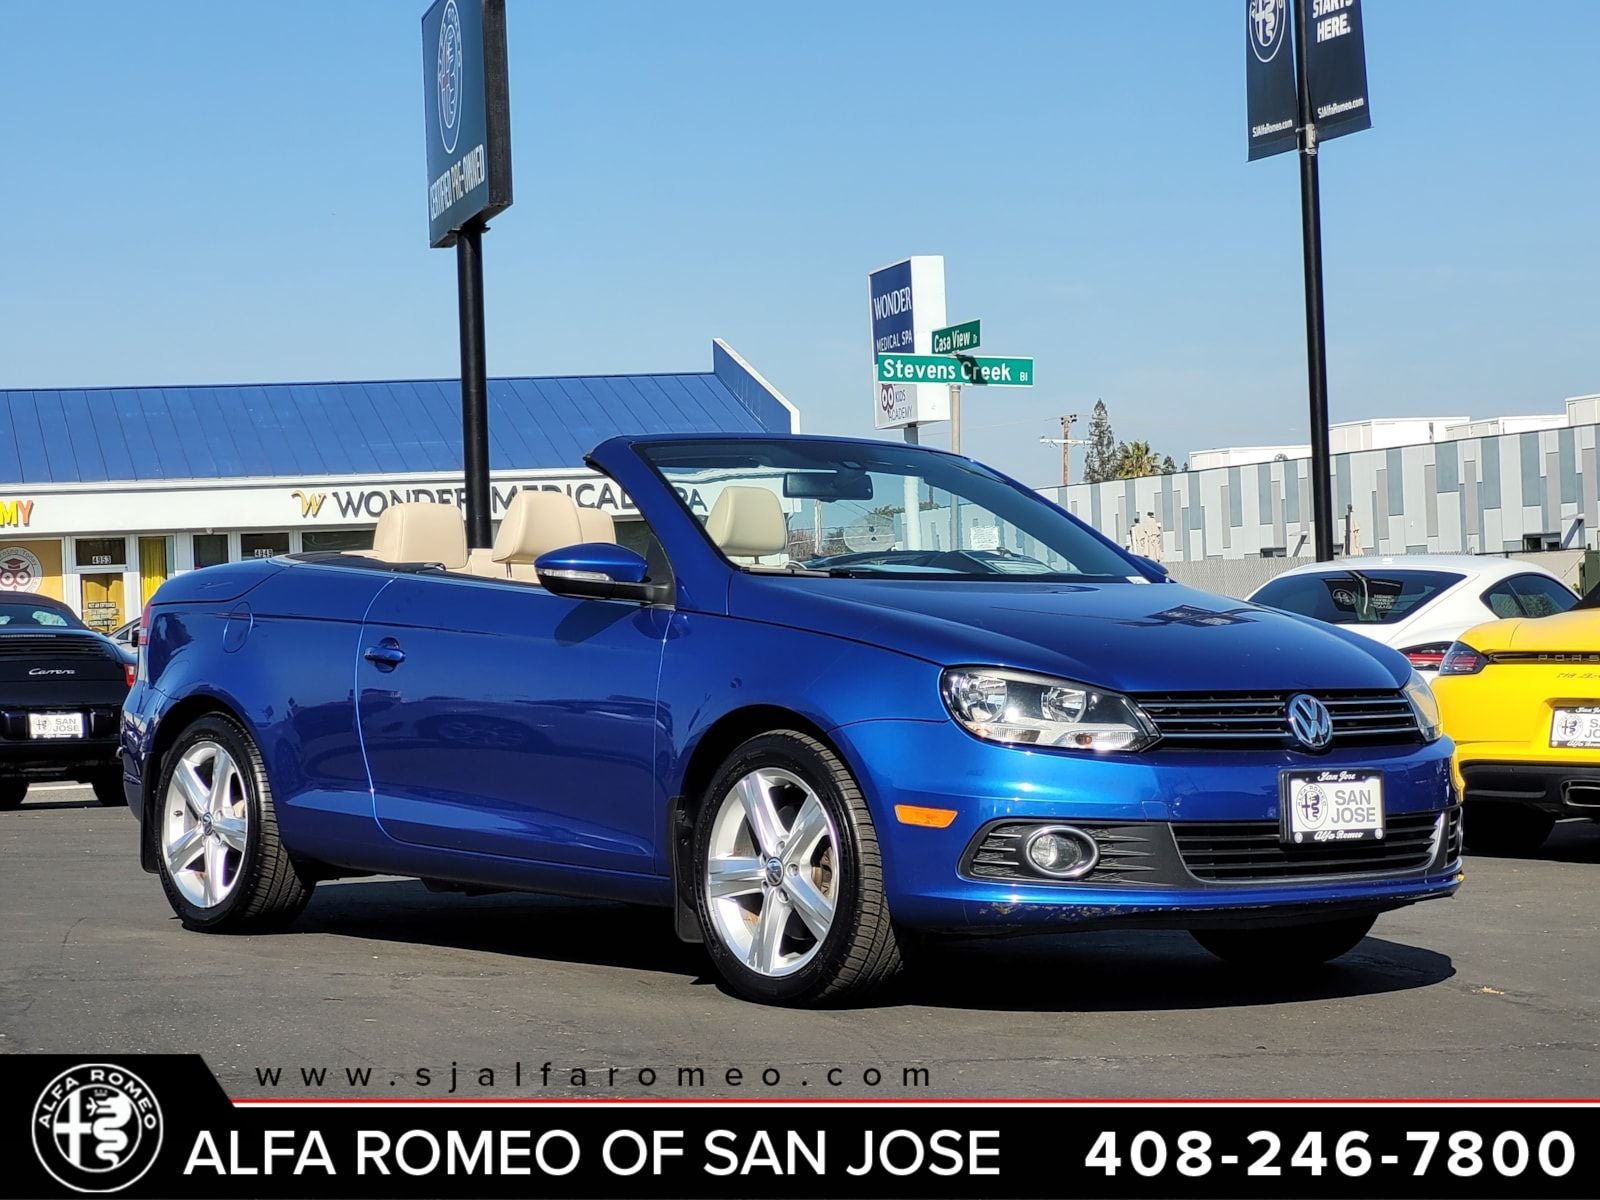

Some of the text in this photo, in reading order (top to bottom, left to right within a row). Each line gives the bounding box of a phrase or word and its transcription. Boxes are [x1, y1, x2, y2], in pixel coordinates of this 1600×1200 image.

[1317, 12, 1351, 43] HERE.
[1317, 97, 1364, 119] SJAlfaRomeo.com
[1252, 119, 1293, 138] SJAlfaRomeo.com
[451, 144, 485, 204] PRE-OWNED
[873, 286, 912, 320] WONDER
[876, 329, 913, 353] MEDICAL SPA
[934, 335, 951, 353] Casa
[952, 329, 970, 348] View
[883, 358, 956, 380] Stevens
[960, 361, 1012, 381] Creek
[673, 486, 708, 512] PA
[53, 724, 80, 732] JOSE
[1317, 770, 1356, 782] San Jose
[1334, 789, 1371, 806] SAN
[1331, 807, 1376, 824] JOSE
[1313, 830, 1364, 842] Alfa Romeo
